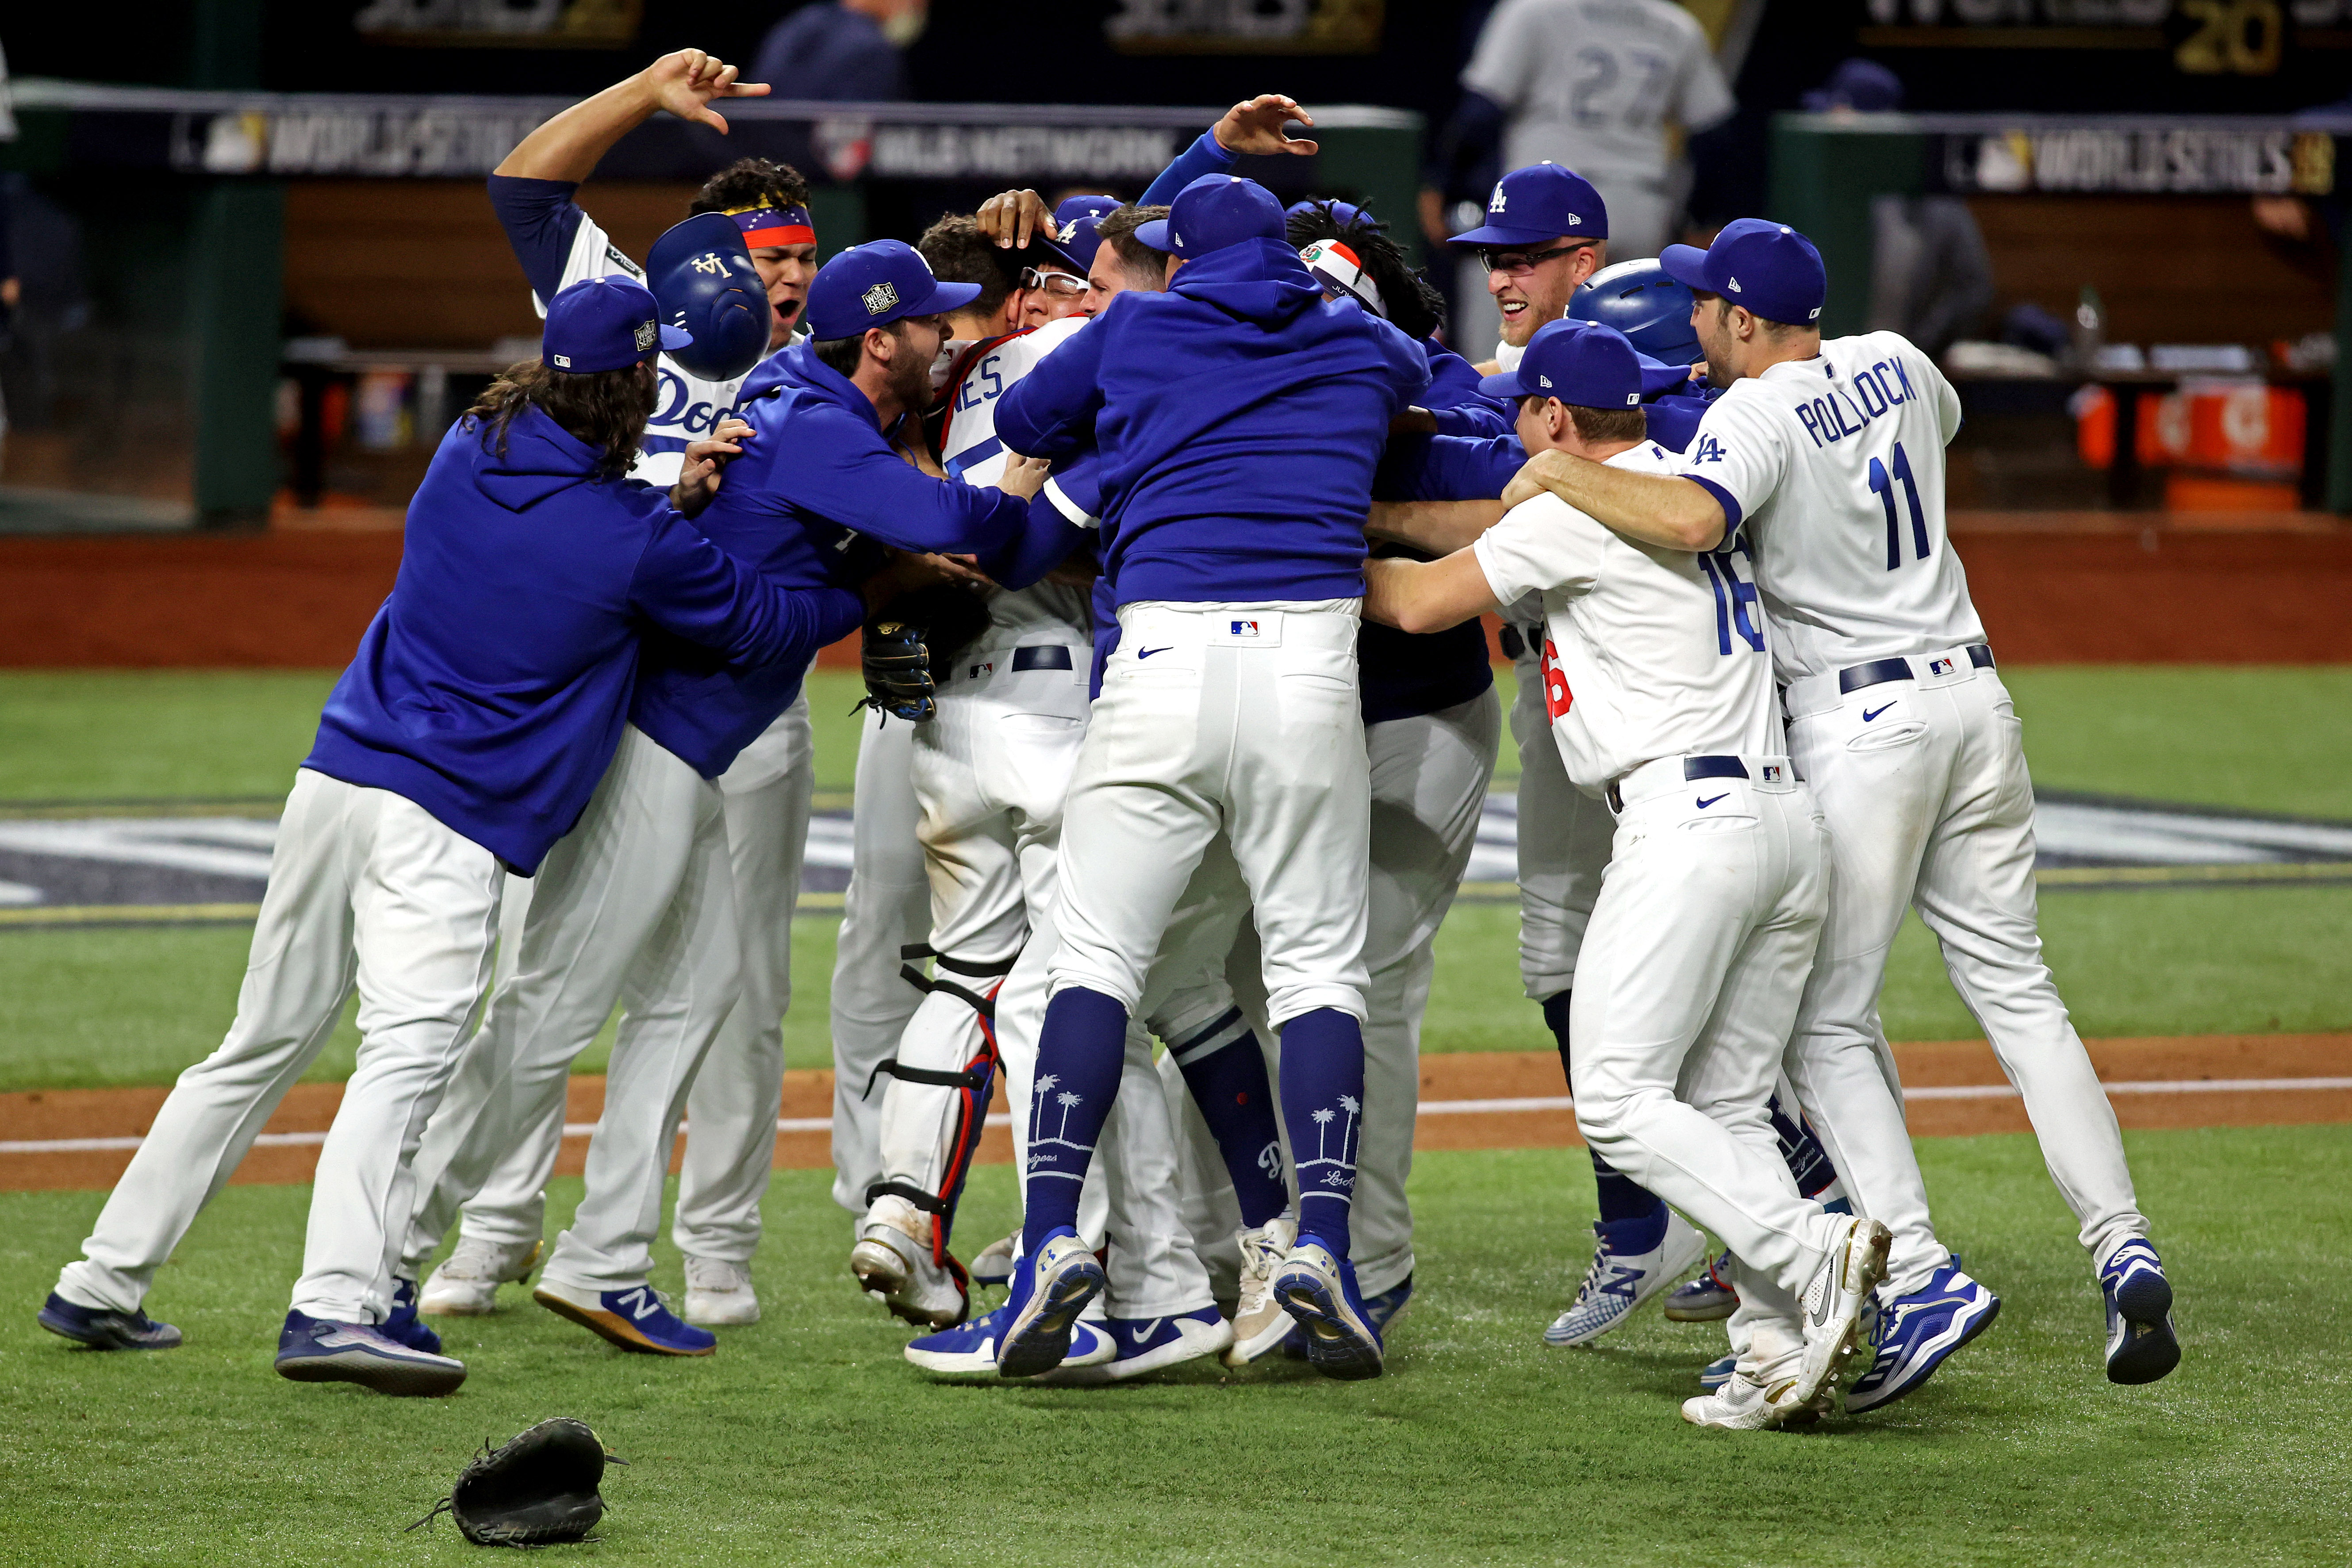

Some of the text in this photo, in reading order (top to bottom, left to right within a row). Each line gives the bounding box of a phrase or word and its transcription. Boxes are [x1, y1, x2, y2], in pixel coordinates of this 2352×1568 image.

[1571, 45, 1669, 128] 27
[865, 286, 892, 304] WORLD
[869, 293, 895, 311] SERIES
[637, 323, 655, 339] WORLD
[639, 333, 656, 347] SERIES
[1795, 356, 1917, 449] POLLOCK
[1869, 441, 1930, 571] 11
[1698, 533, 1766, 656] 16
